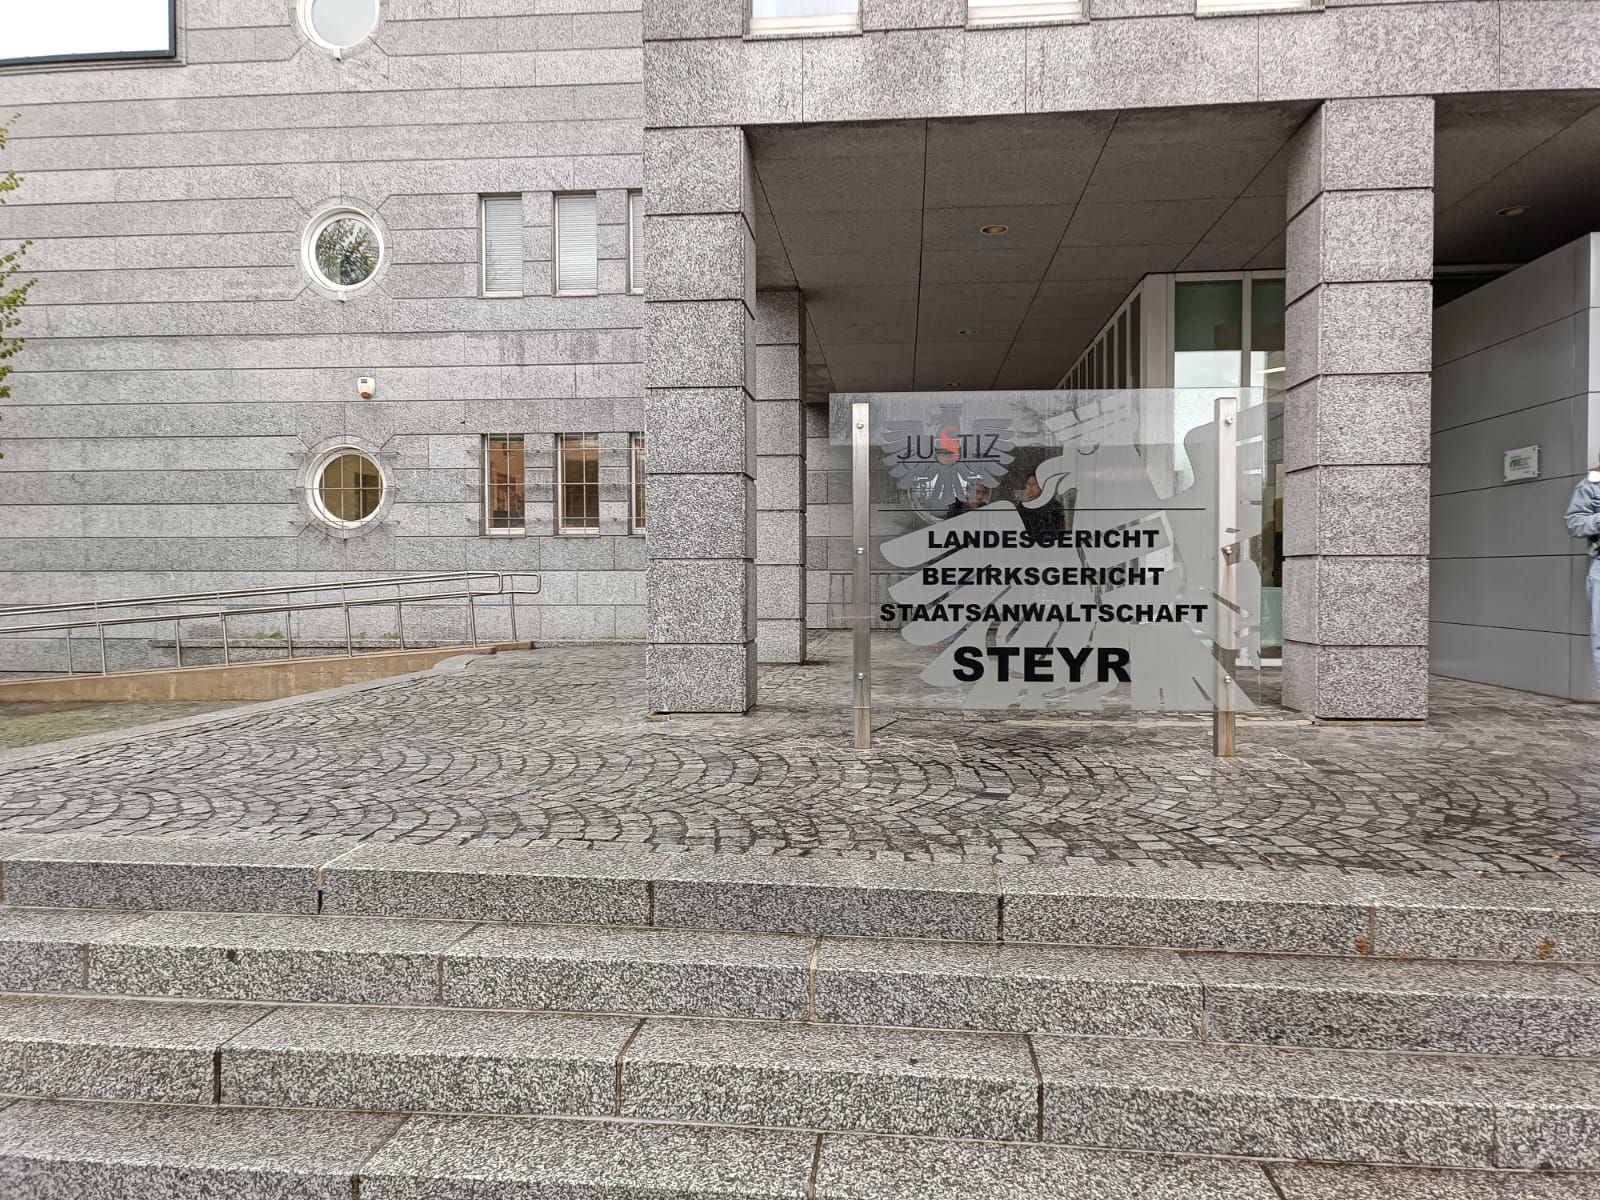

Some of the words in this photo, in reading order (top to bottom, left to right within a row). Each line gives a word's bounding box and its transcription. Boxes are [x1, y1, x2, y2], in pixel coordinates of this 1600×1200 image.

[897, 426, 1000, 464] JUSTIZ
[927, 530, 1160, 549] LANDESGERICHT
[922, 567, 1165, 586] BEZIRKSGERICHT
[880, 604, 1208, 623] STAATSANWALTSCHAFT
[953, 646, 1132, 683] STEYR
